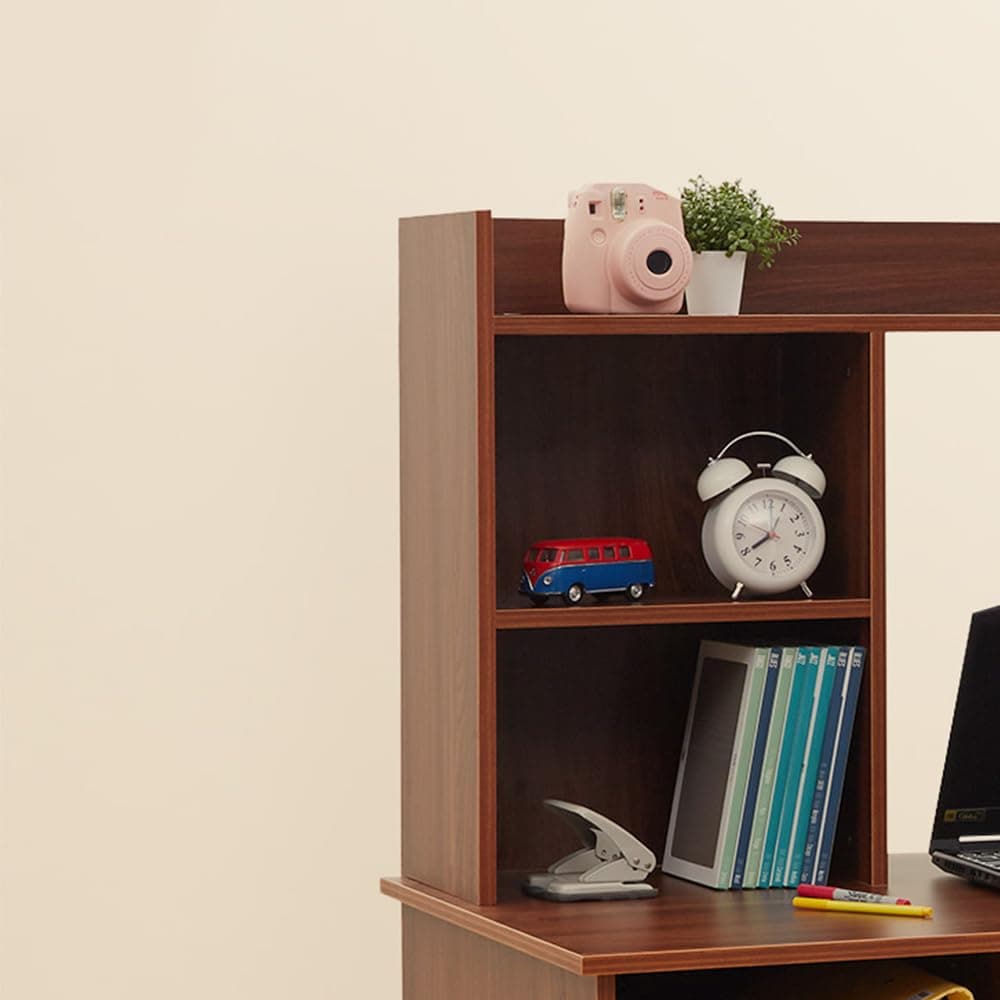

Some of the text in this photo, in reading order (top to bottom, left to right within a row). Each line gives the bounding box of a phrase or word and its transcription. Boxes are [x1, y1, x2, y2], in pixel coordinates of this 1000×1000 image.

[789, 514, 800, 523] 2
[736, 532, 745, 540] 9
[740, 546, 751, 556] 8
[793, 544, 803, 554] 4
[754, 556, 762, 567] 7
[769, 560, 777, 571] 6
[783, 555, 792, 567] 5
